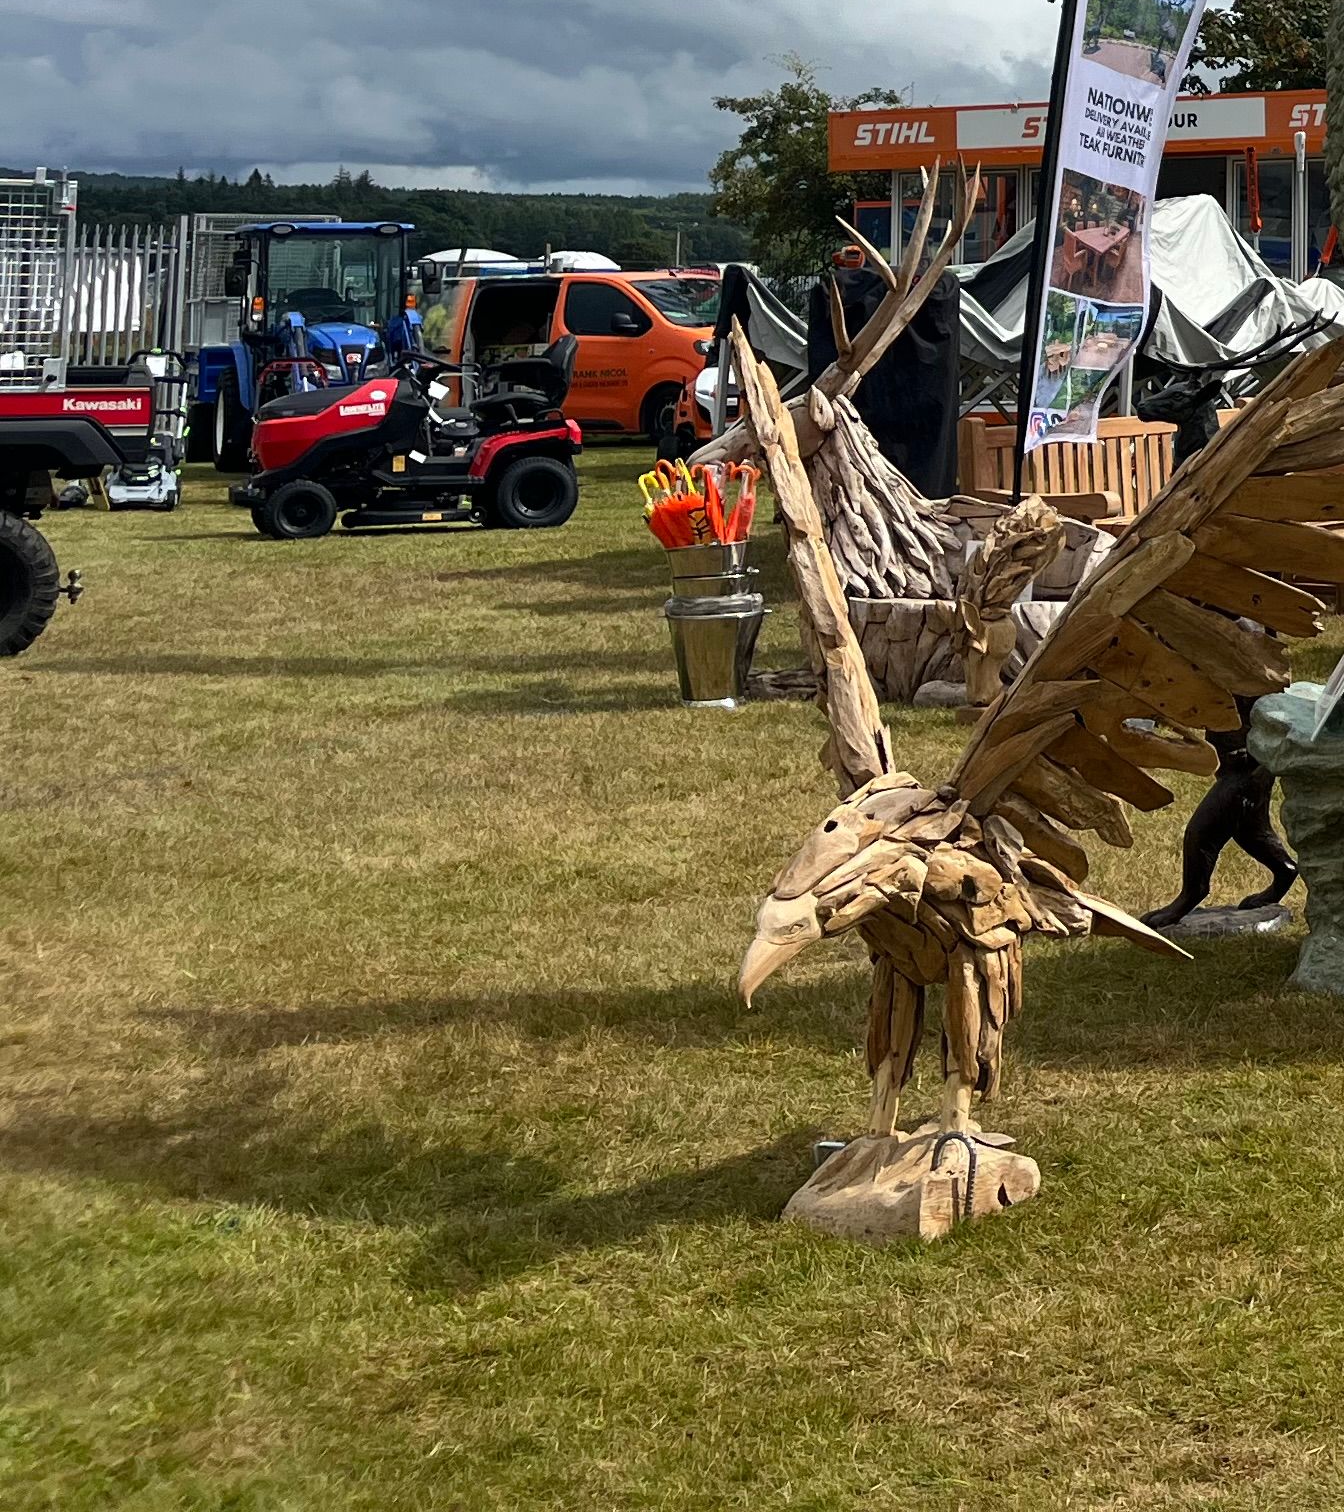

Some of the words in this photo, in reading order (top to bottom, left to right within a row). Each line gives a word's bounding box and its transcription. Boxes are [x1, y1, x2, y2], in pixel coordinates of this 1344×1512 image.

[854, 121, 935, 146] STIHL
[1079, 132, 1101, 153] TEAK
[62, 398, 142, 411] Kawasaki
